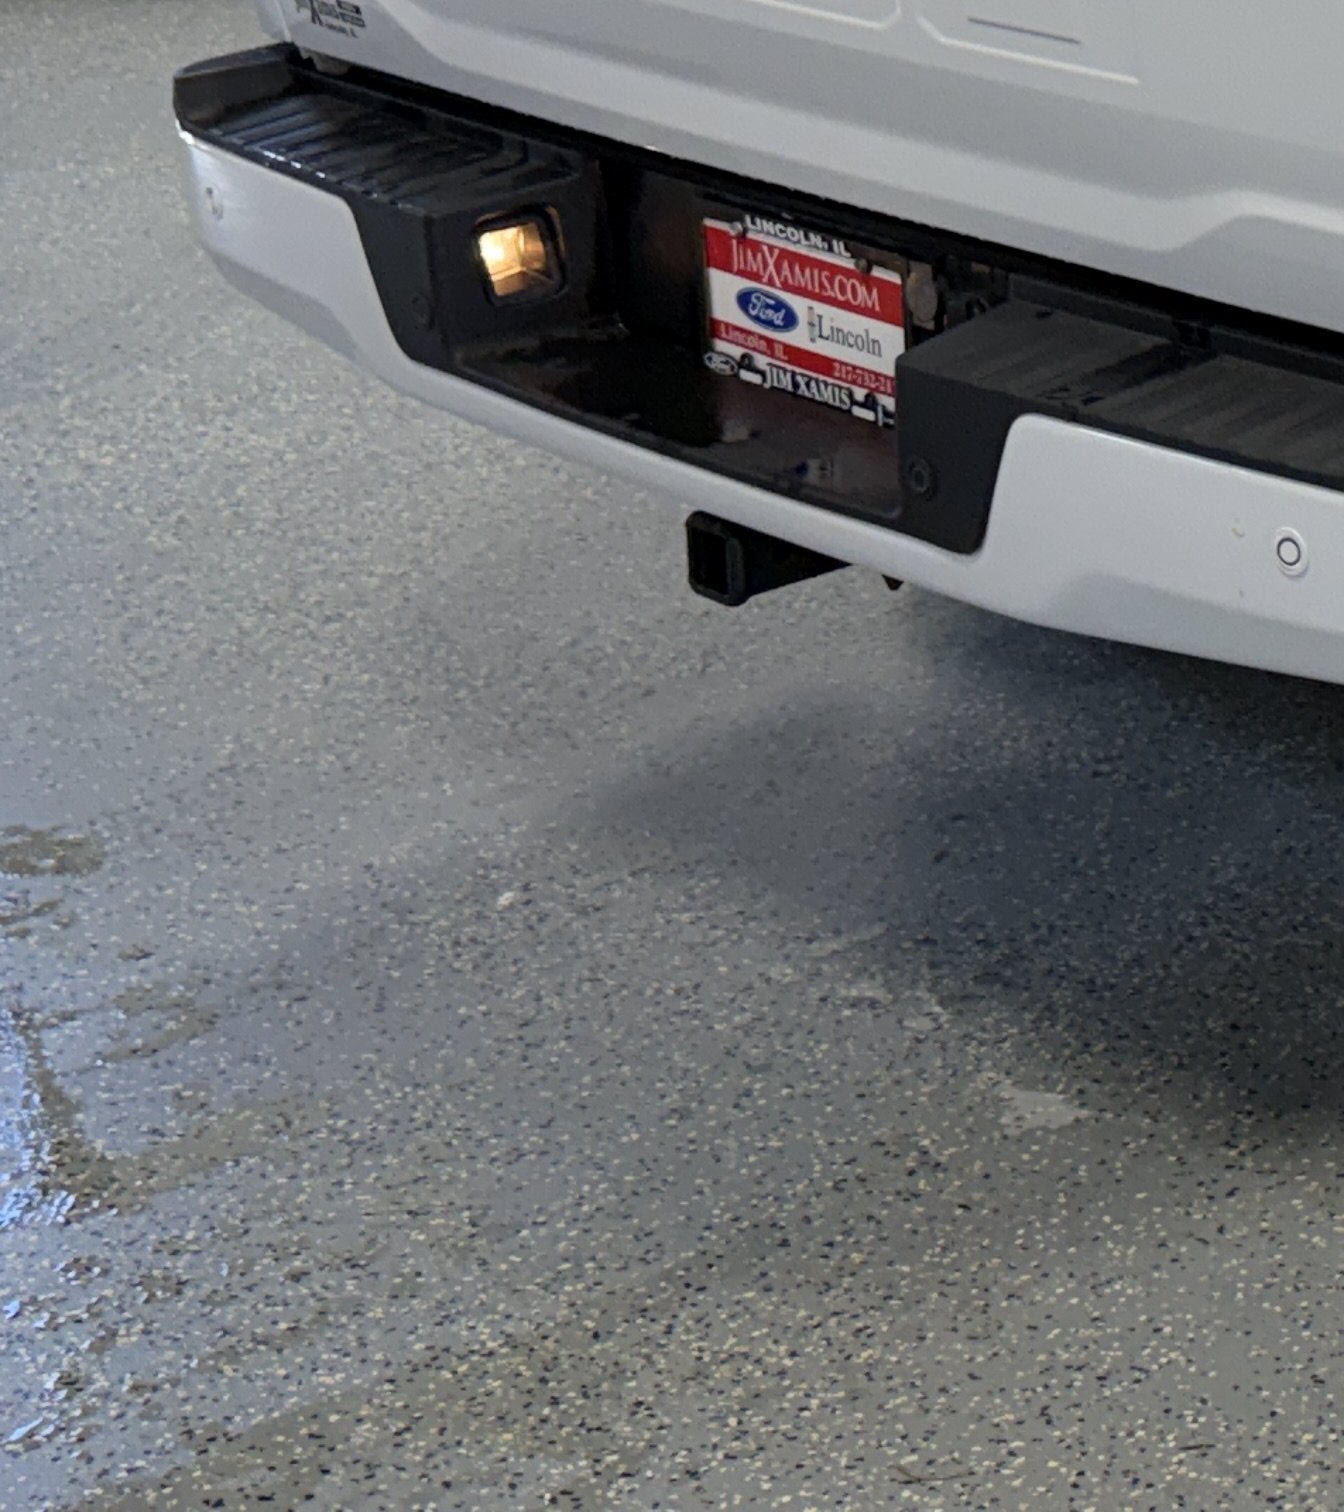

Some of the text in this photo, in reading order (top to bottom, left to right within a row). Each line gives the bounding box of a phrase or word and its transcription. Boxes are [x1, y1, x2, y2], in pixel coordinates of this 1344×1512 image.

[744, 214, 852, 257] LINCOLN, IL
[748, 292, 883, 358] Ford Lincoln
[762, 363, 795, 389] JIM
[794, 373, 852, 411] XAMIS
